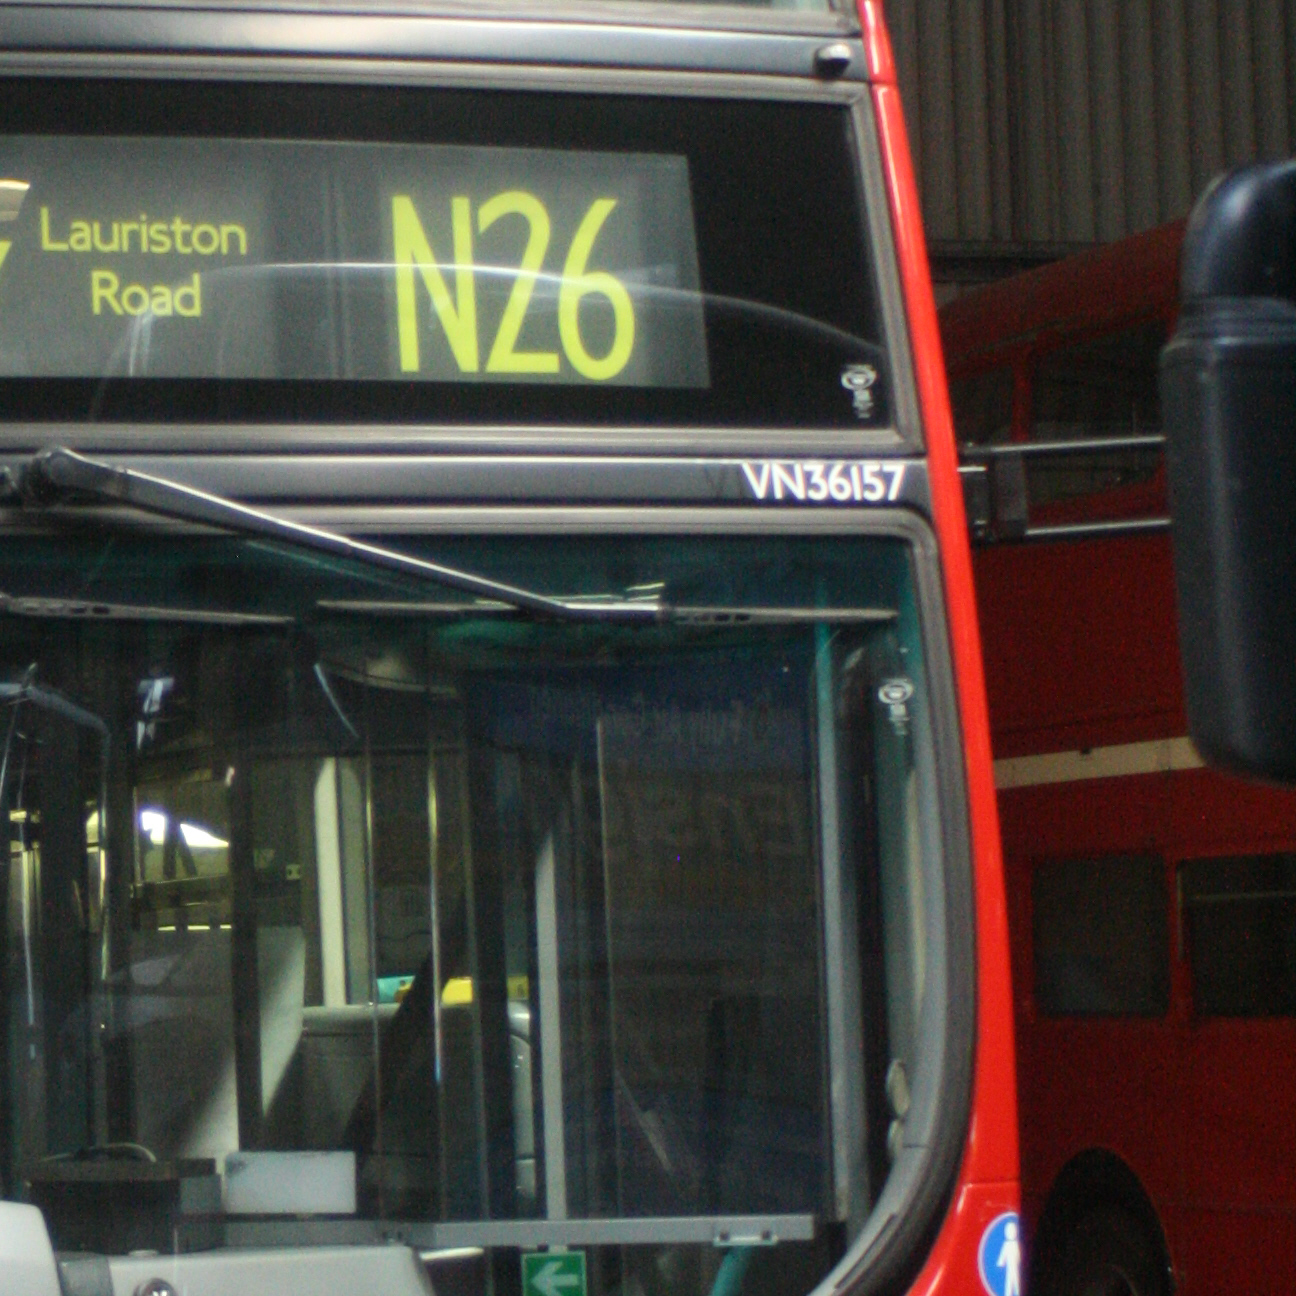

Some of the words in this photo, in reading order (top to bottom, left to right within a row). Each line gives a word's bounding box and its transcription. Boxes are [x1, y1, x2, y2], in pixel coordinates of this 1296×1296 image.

[41, 205, 247, 257] Lauriston
[91, 270, 202, 318] Road
[390, 190, 636, 382] N26
[741, 461, 905, 502] VN36157
